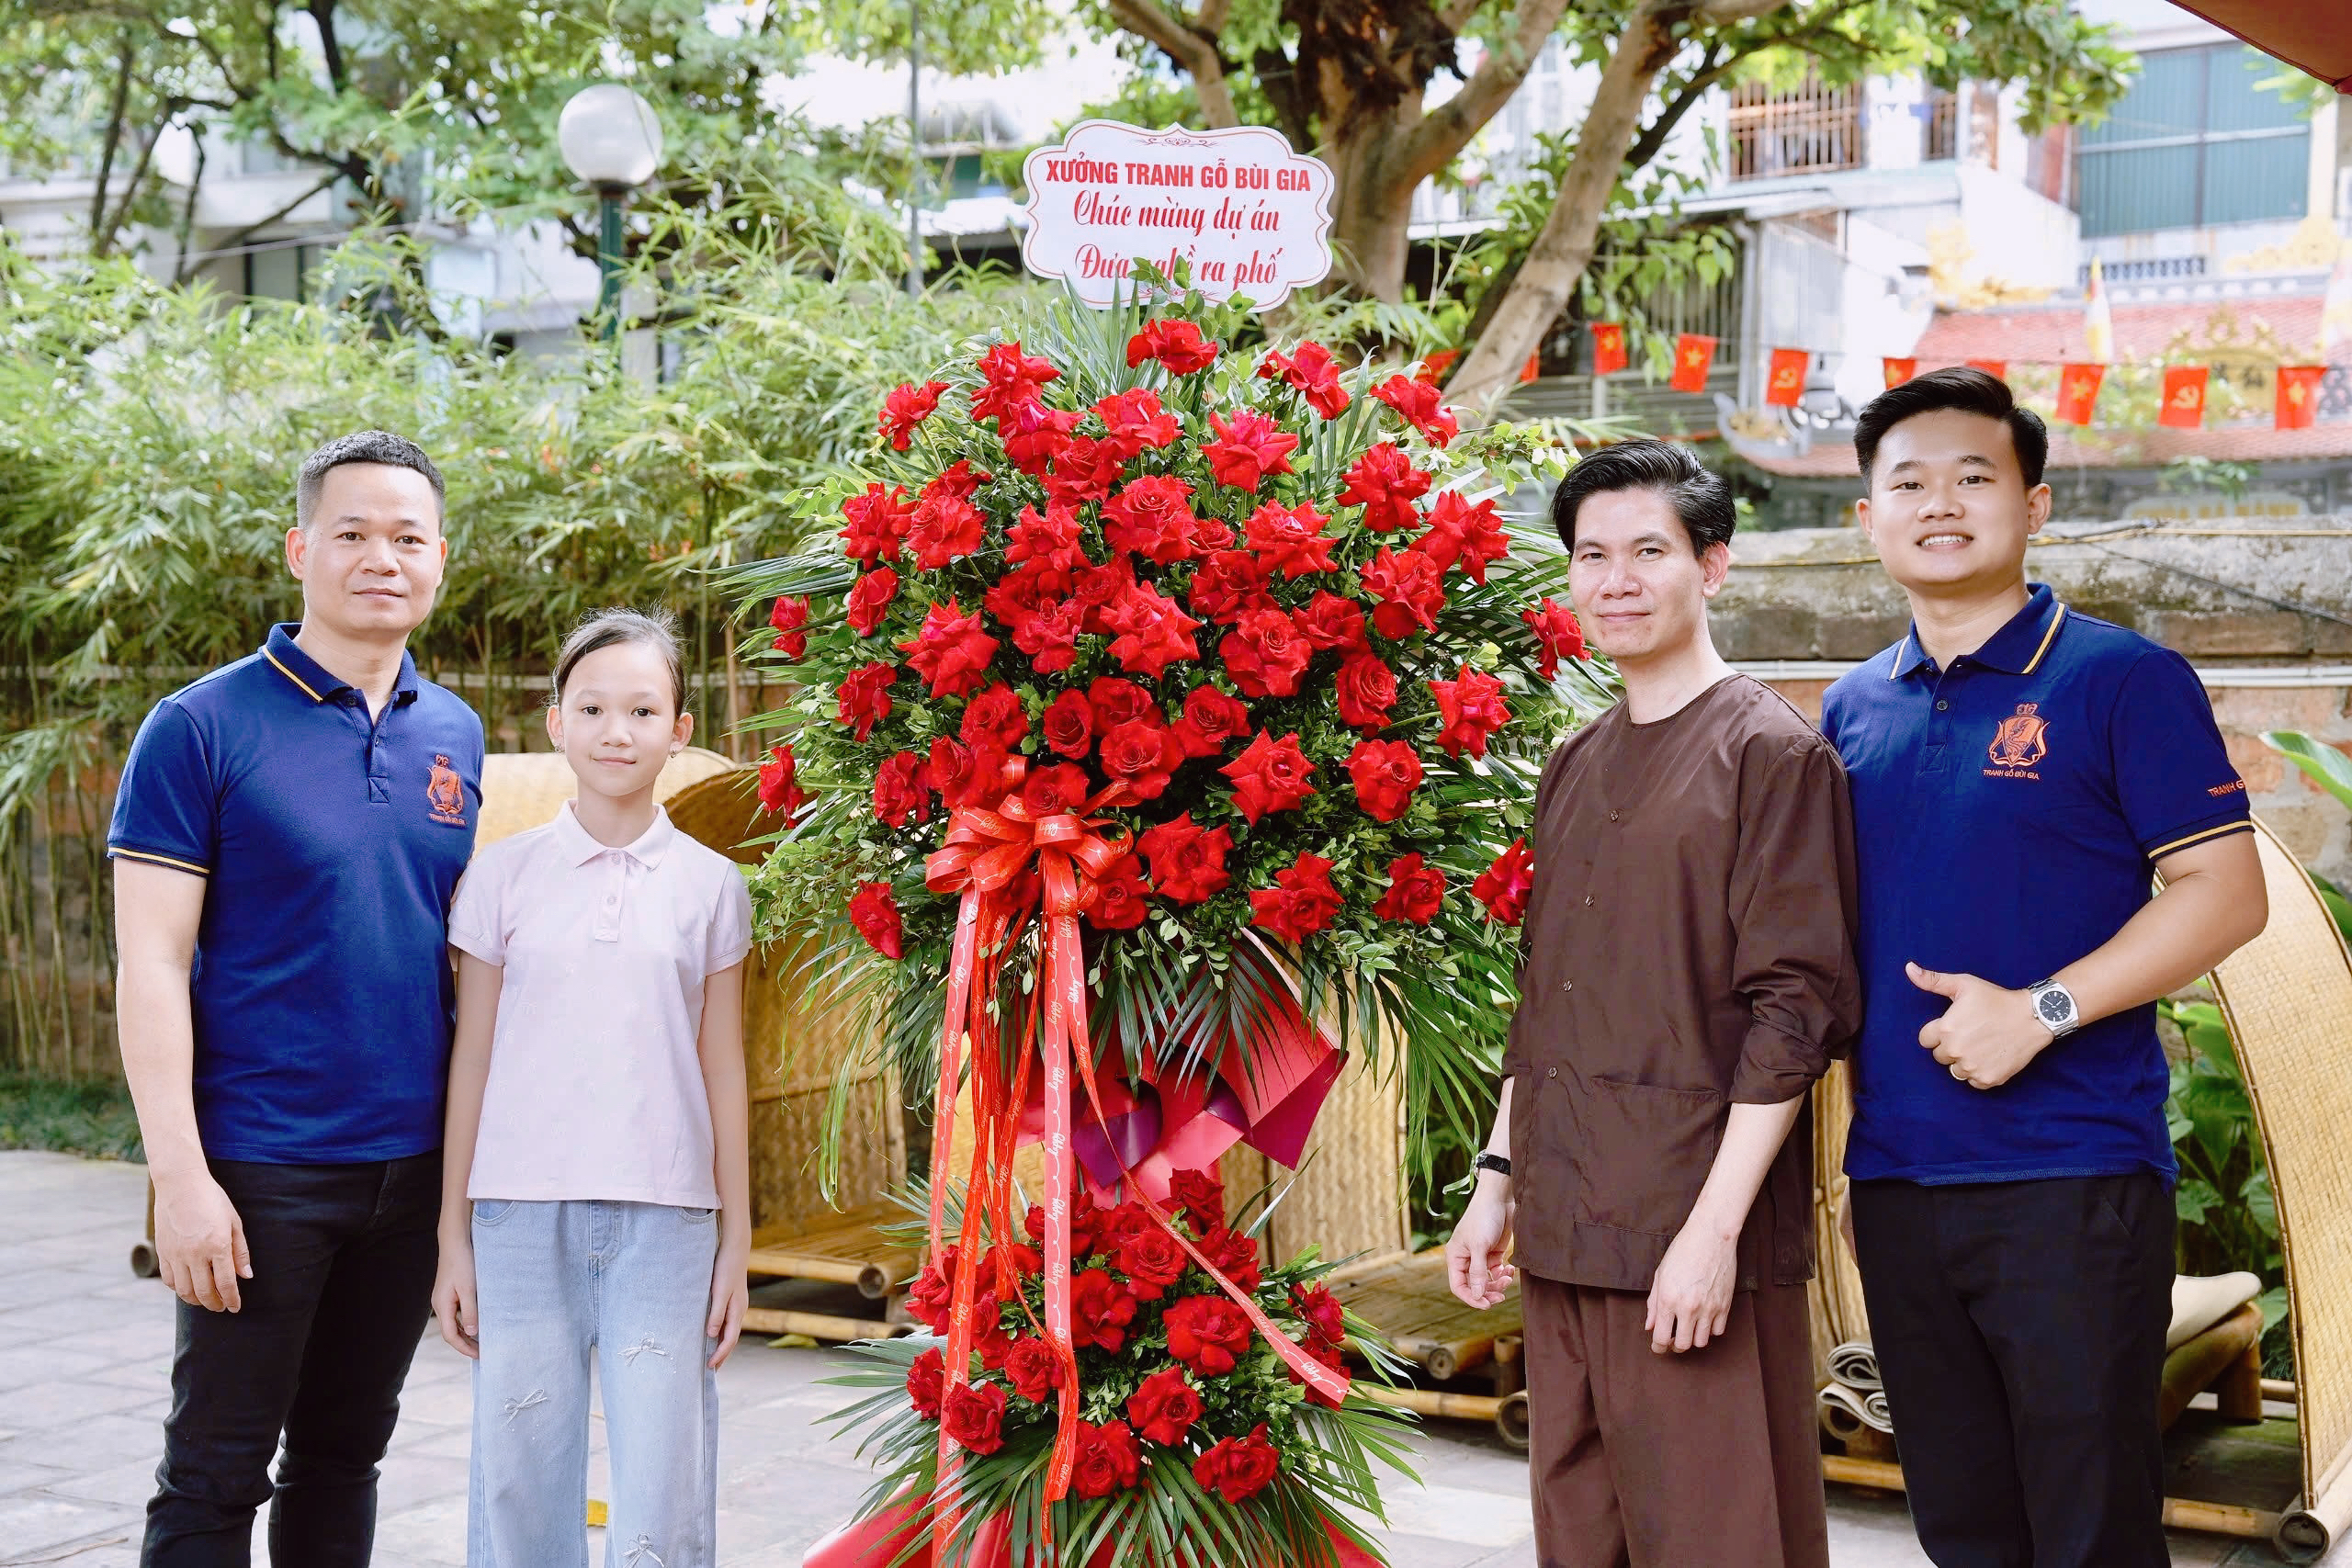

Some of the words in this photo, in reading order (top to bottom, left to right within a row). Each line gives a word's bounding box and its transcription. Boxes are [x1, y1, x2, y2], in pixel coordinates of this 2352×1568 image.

[1046, 152, 1118, 185] XƯỞNG
[1125, 163, 1193, 187] TRANH
[1200, 158, 1229, 189] GỖ
[1235, 163, 1269, 191] BÙI
[1276, 169, 1311, 192] GIA
[1073, 189, 1133, 228] Chúc
[1138, 196, 1206, 237] mừng
[1213, 196, 1247, 240] dự
[1250, 198, 1281, 232] án
[1075, 243, 1130, 279] Đưa
[1200, 258, 1225, 282] ra
[1232, 247, 1283, 291] phố
